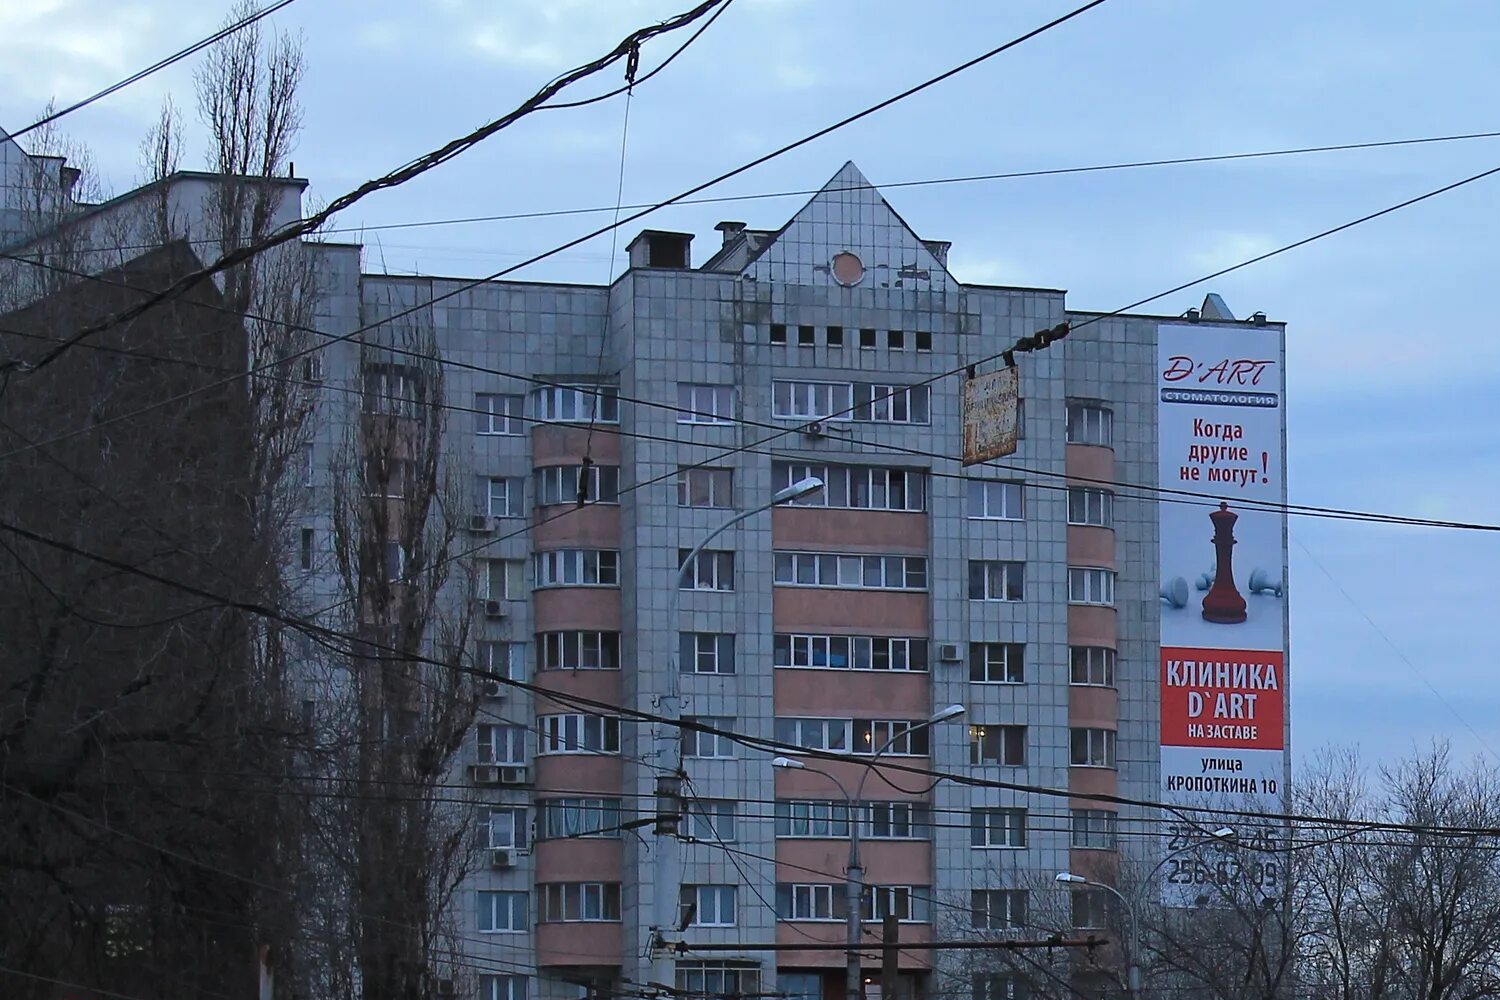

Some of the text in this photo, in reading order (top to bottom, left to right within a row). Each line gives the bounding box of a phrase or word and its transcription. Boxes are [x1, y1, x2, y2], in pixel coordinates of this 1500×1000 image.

[1165, 391, 1275, 405] СТОМАТОЛОГИЯ
[1193, 418, 1243, 441] Когда
[1189, 445, 1248, 464] другие
[1180, 465, 1200, 481] не
[1167, 660, 1278, 691] КЛИНИКА
[1188, 724, 1257, 740] НА ЗАСТАВЕ
[1201, 758, 1243, 773] улица
[1168, 775, 1277, 795] КРОПОТКИНА 10
